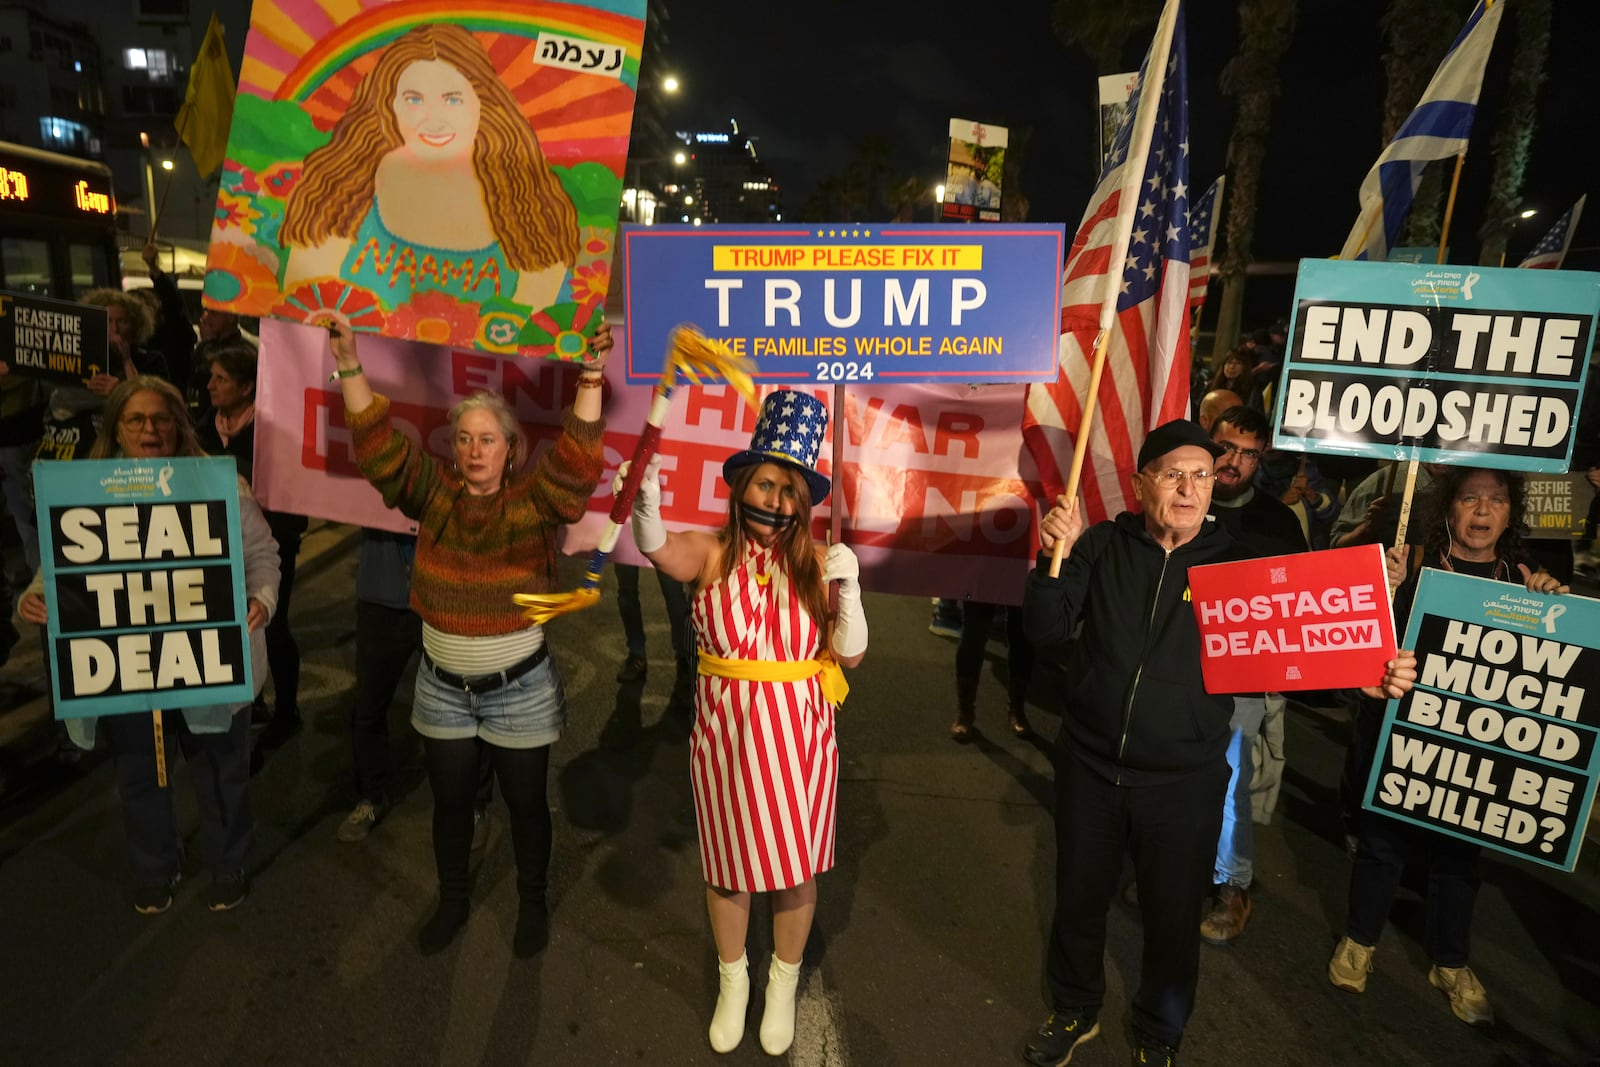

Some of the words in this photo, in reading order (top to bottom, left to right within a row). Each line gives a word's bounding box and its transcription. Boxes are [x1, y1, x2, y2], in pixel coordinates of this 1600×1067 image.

[542, 40, 621, 71] נעמה
[351, 237, 501, 296] NAAMA
[730, 248, 805, 267] TRUMP
[812, 248, 895, 267] PLEASE
[903, 248, 935, 267] FIX
[941, 248, 960, 267] IT
[14, 306, 82, 335] CEASEFIRE
[704, 278, 987, 329] TRUMP
[14, 325, 82, 356] HOSTAGE
[15, 346, 47, 369] DEAL
[48, 352, 82, 376] NOW!
[753, 336, 847, 356] FAMILIES
[854, 336, 932, 355] WHOLE
[938, 336, 1003, 355] AGAIN
[1300, 305, 1433, 365] END
[1451, 313, 1581, 376] THE
[816, 361, 874, 382] 2024
[1283, 378, 1571, 449] BLOODSHED
[60, 503, 222, 564] SEAL
[1539, 513, 1572, 529] NOW!
[85, 568, 207, 628] THE
[1200, 584, 1377, 625] HOSTAGE
[69, 628, 233, 697] DEAL
[1204, 627, 1301, 658] DEAL
[1307, 624, 1374, 648] NOW
[1441, 620, 1584, 679] HOW
[1420, 653, 1586, 722] MUCH
[1407, 690, 1580, 761] BLOOD
[1391, 733, 1497, 796] WILL
[1507, 767, 1575, 816] BE
[1379, 772, 1566, 853] SPILLED?
